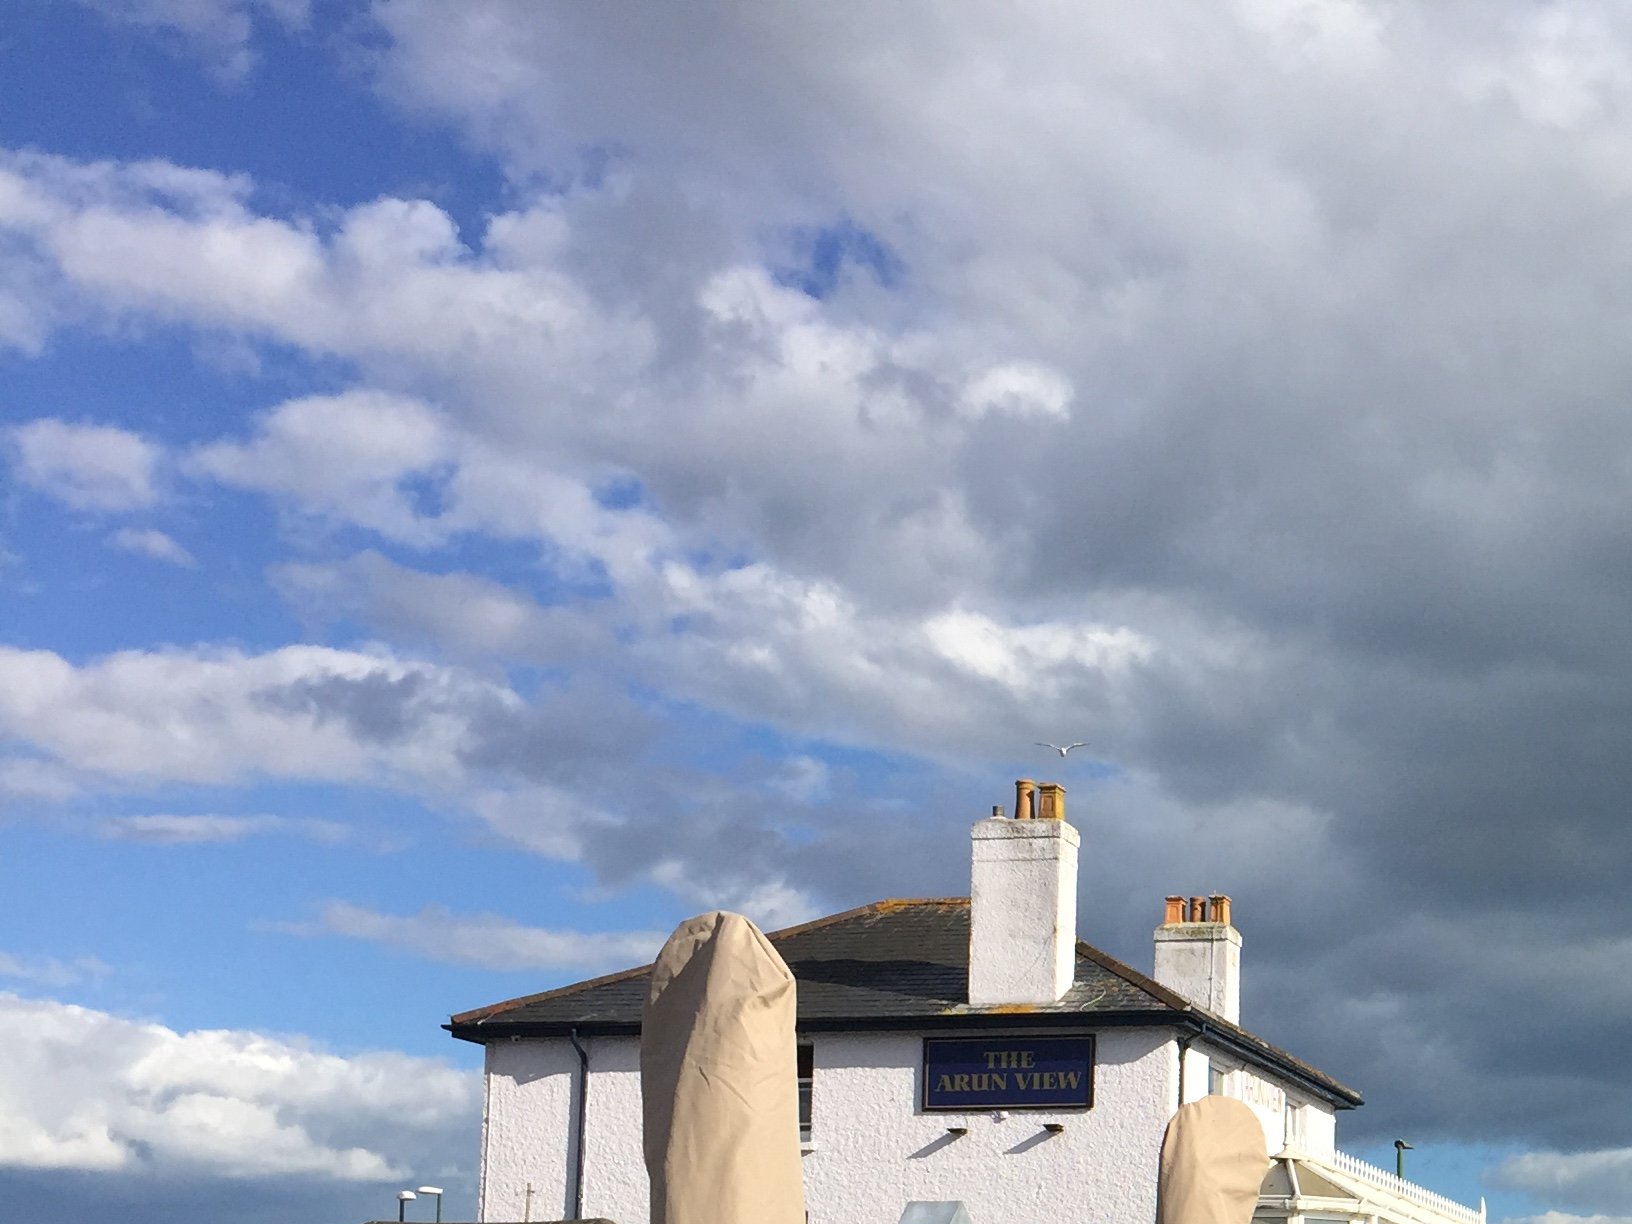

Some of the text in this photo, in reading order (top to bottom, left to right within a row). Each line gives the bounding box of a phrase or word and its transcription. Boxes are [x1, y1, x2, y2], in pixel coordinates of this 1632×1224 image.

[983, 1050, 1036, 1070] THE
[934, 1071, 1082, 1092] ARUN VIEW
